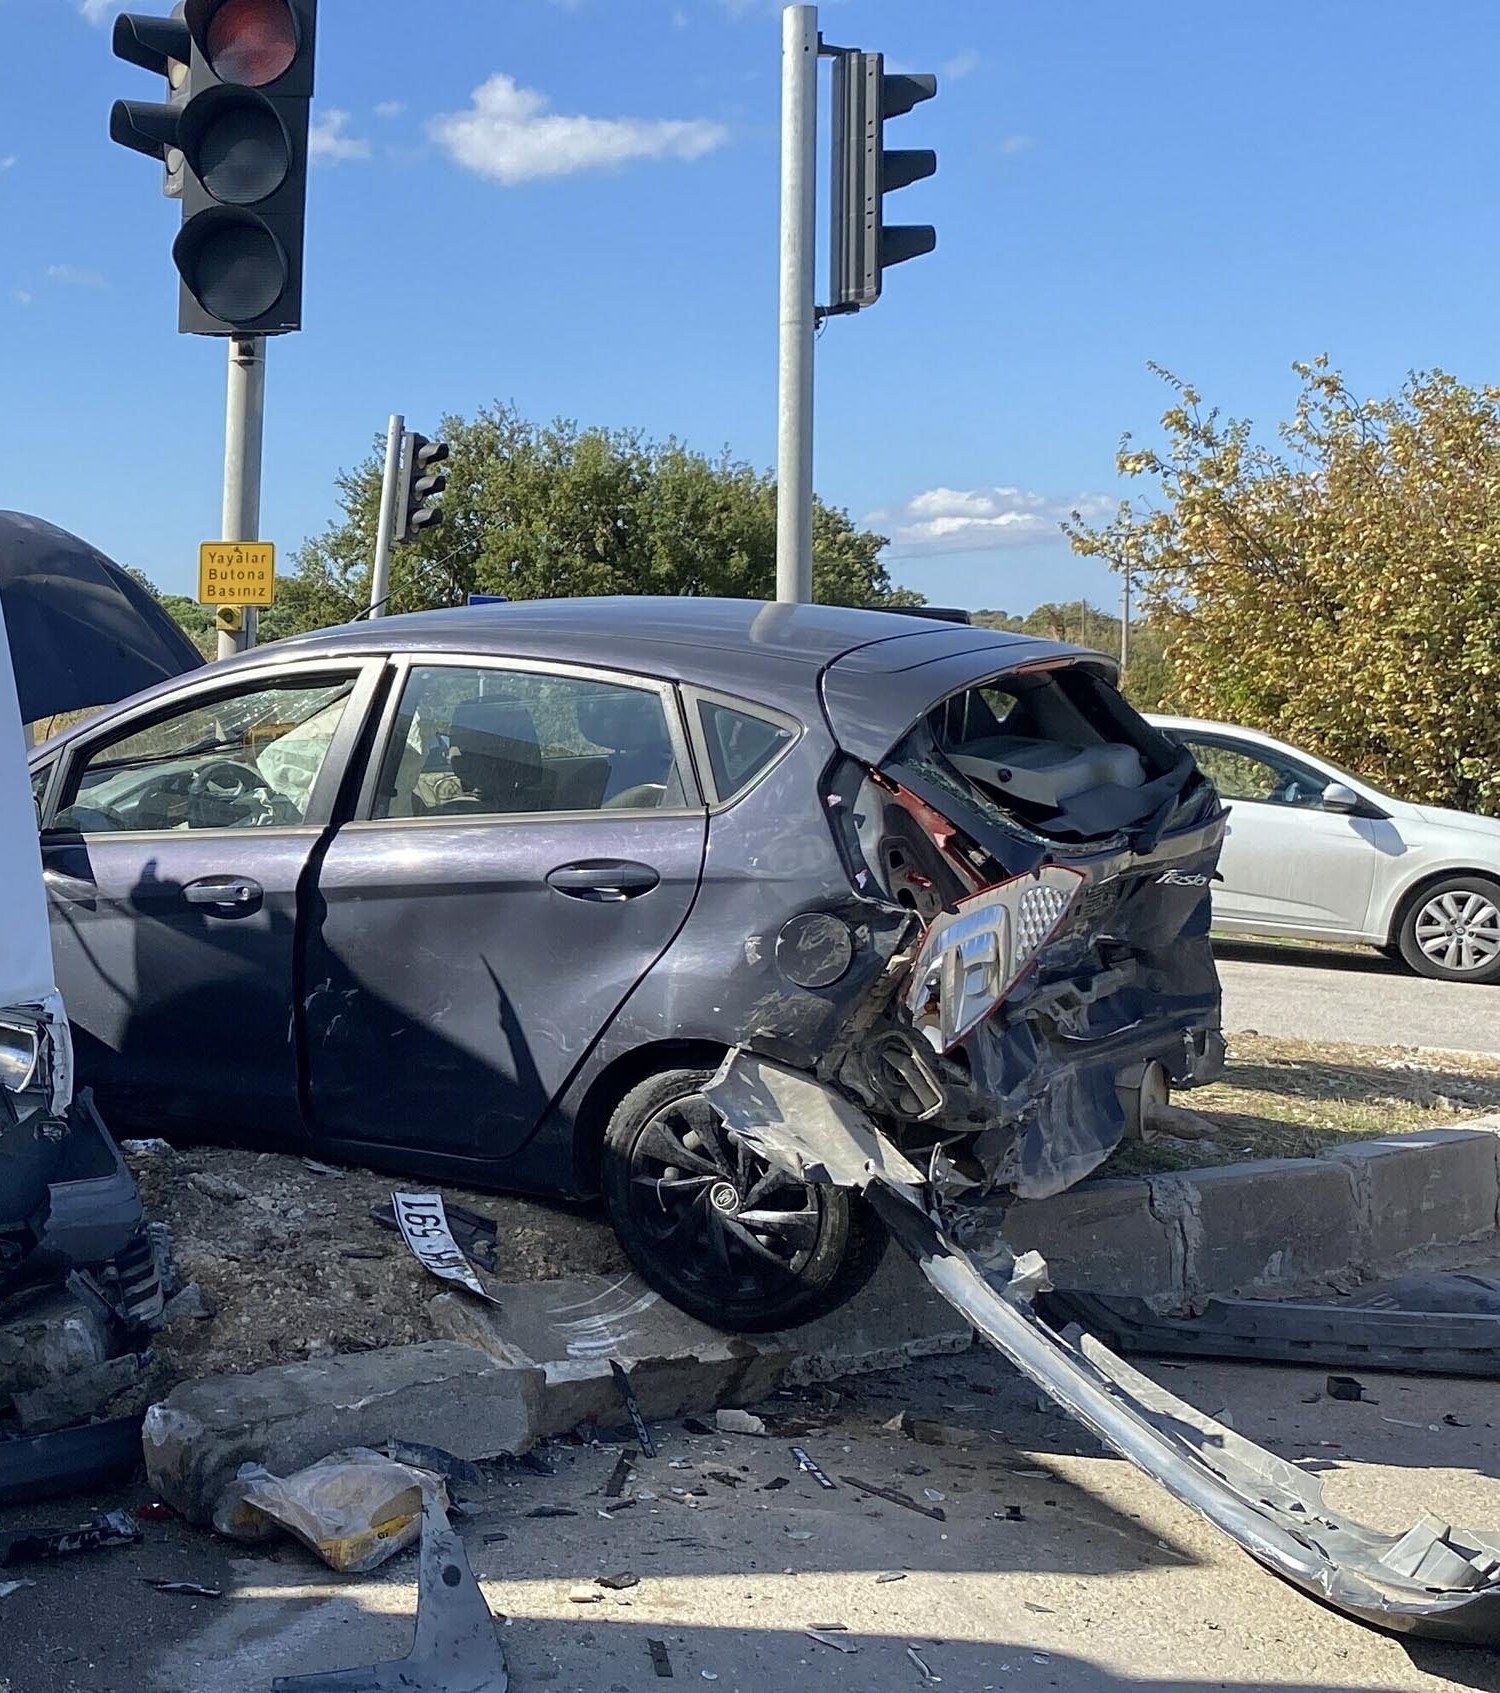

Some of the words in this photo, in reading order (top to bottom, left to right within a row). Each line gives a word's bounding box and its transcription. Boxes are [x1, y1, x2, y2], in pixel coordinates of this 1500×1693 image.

[208, 551, 267, 566] Yayalar
[208, 568, 265, 580] Butona
[207, 584, 266, 597] Basınız
[1155, 869, 1207, 886] Fiesta
[401, 1201, 446, 1238] 591
